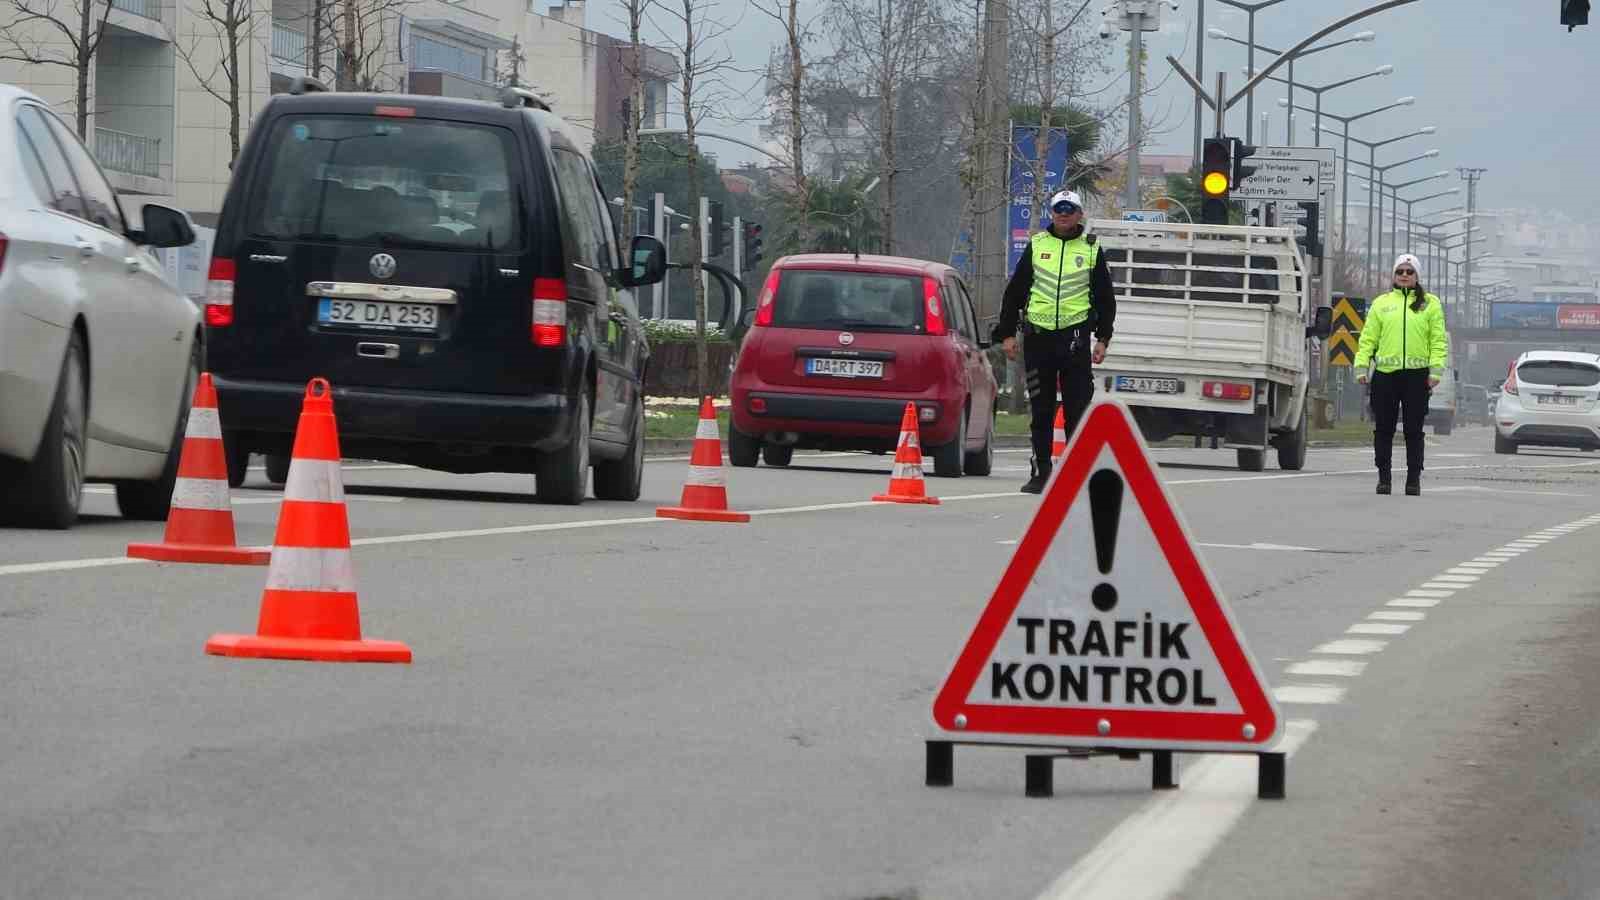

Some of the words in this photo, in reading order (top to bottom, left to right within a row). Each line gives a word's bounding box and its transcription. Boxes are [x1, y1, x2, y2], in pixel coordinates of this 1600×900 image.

[330, 301, 355, 321] 52
[364, 303, 393, 323] DA
[398, 305, 434, 325] 253
[814, 359, 831, 373] DA
[839, 360, 857, 375] RT
[857, 361, 882, 375] 397
[1139, 378, 1154, 391] AY
[1017, 611, 1191, 660] TRAFİK
[991, 662, 1217, 707] KONTROL
